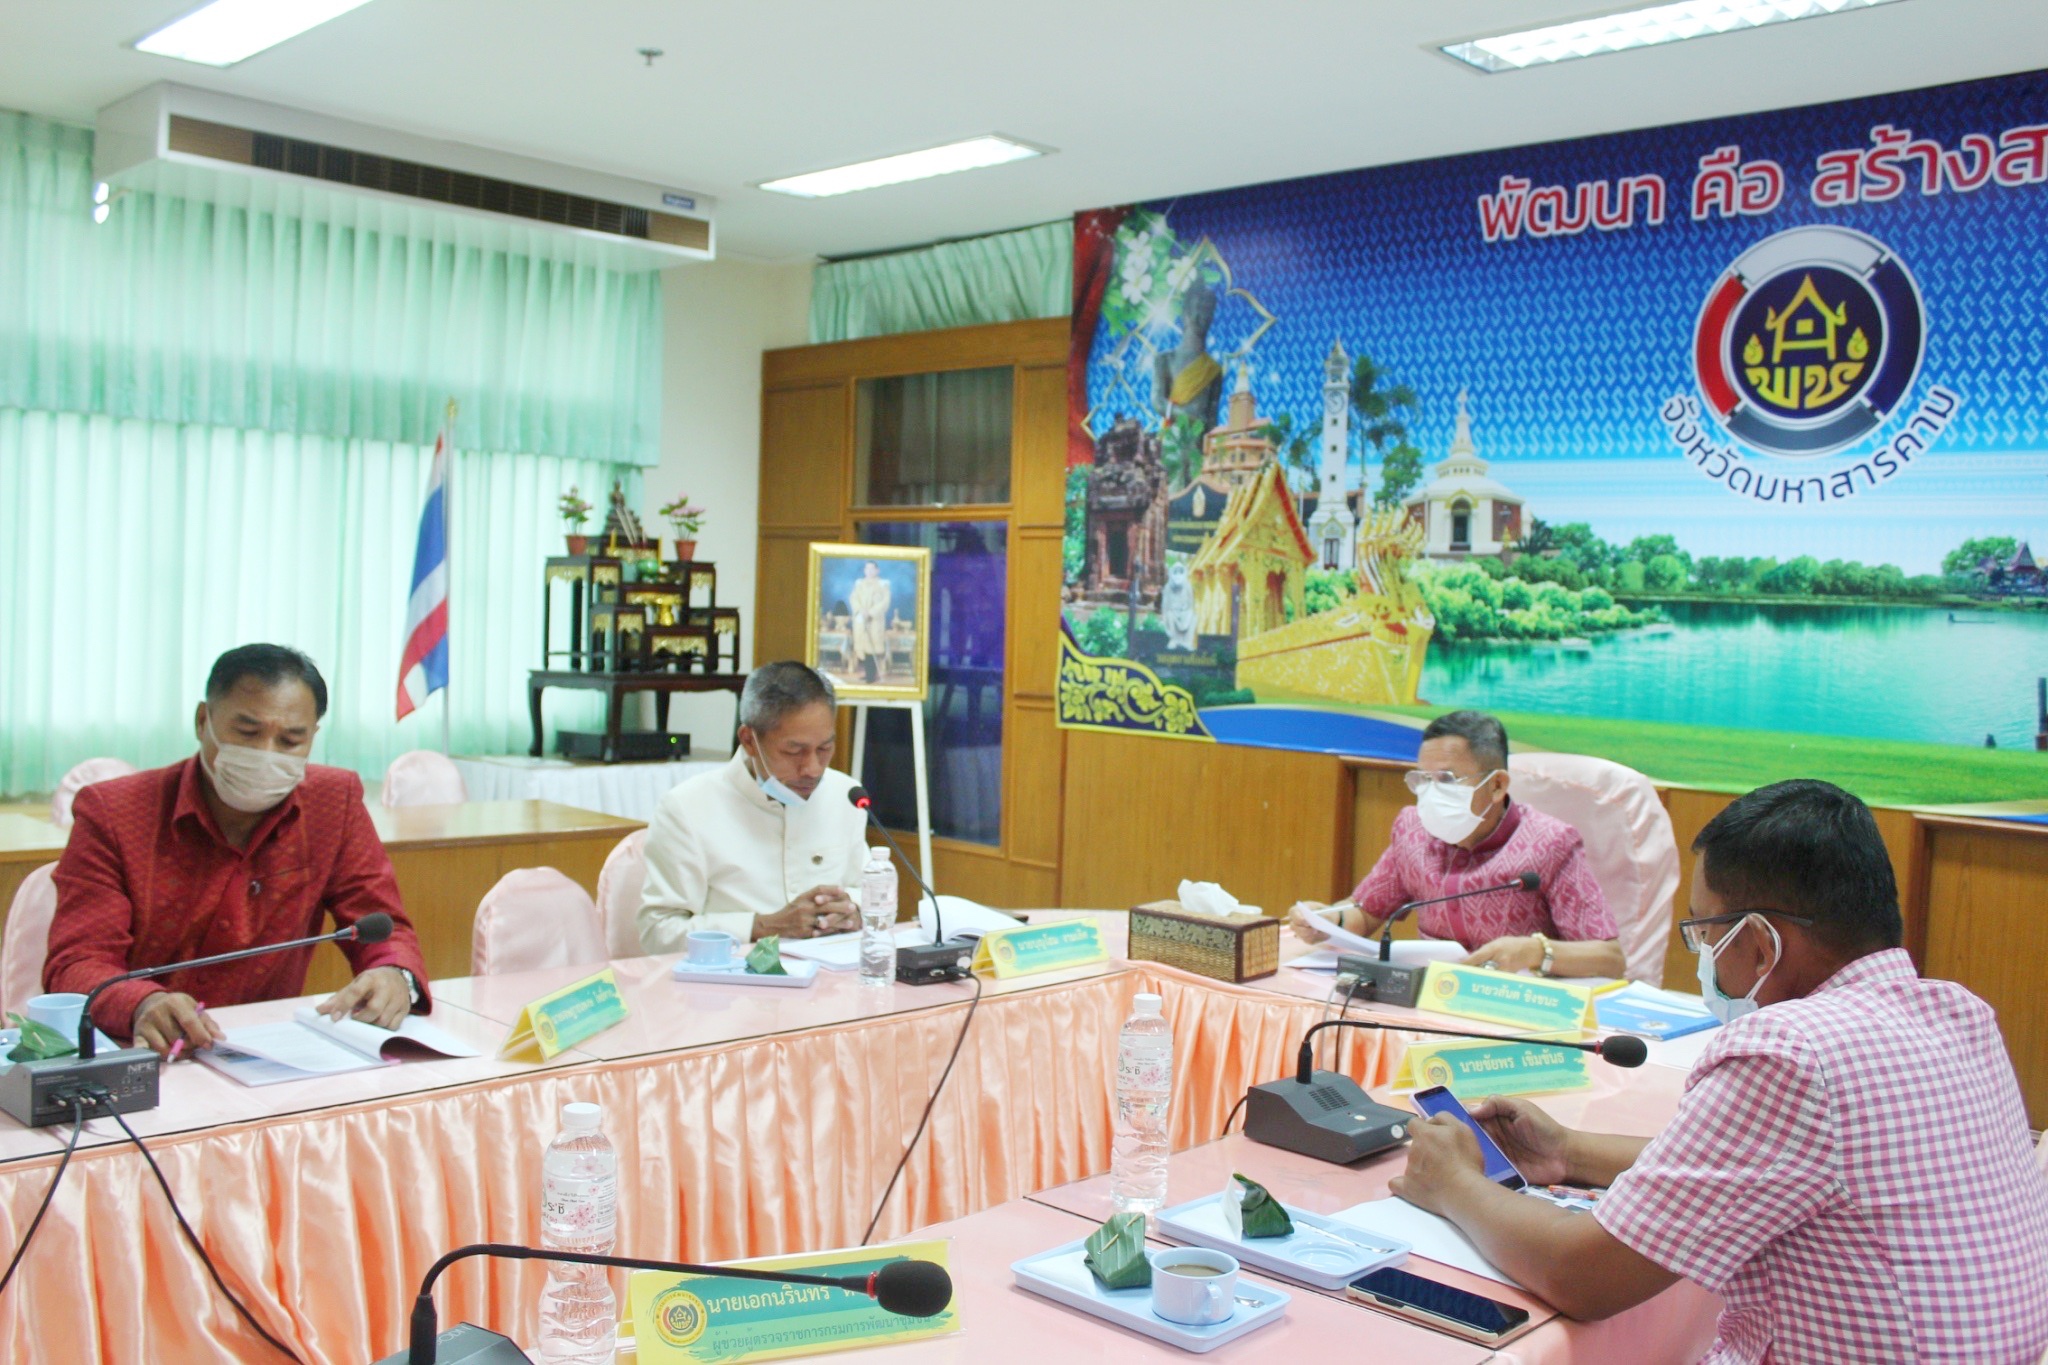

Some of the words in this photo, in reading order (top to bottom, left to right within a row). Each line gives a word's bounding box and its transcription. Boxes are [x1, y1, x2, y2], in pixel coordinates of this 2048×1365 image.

[1479, 176, 1664, 242] พัฒนา
[1692, 145, 1784, 221] คือ
[1661, 385, 1956, 504] จังหวัดมหาสารคาม
